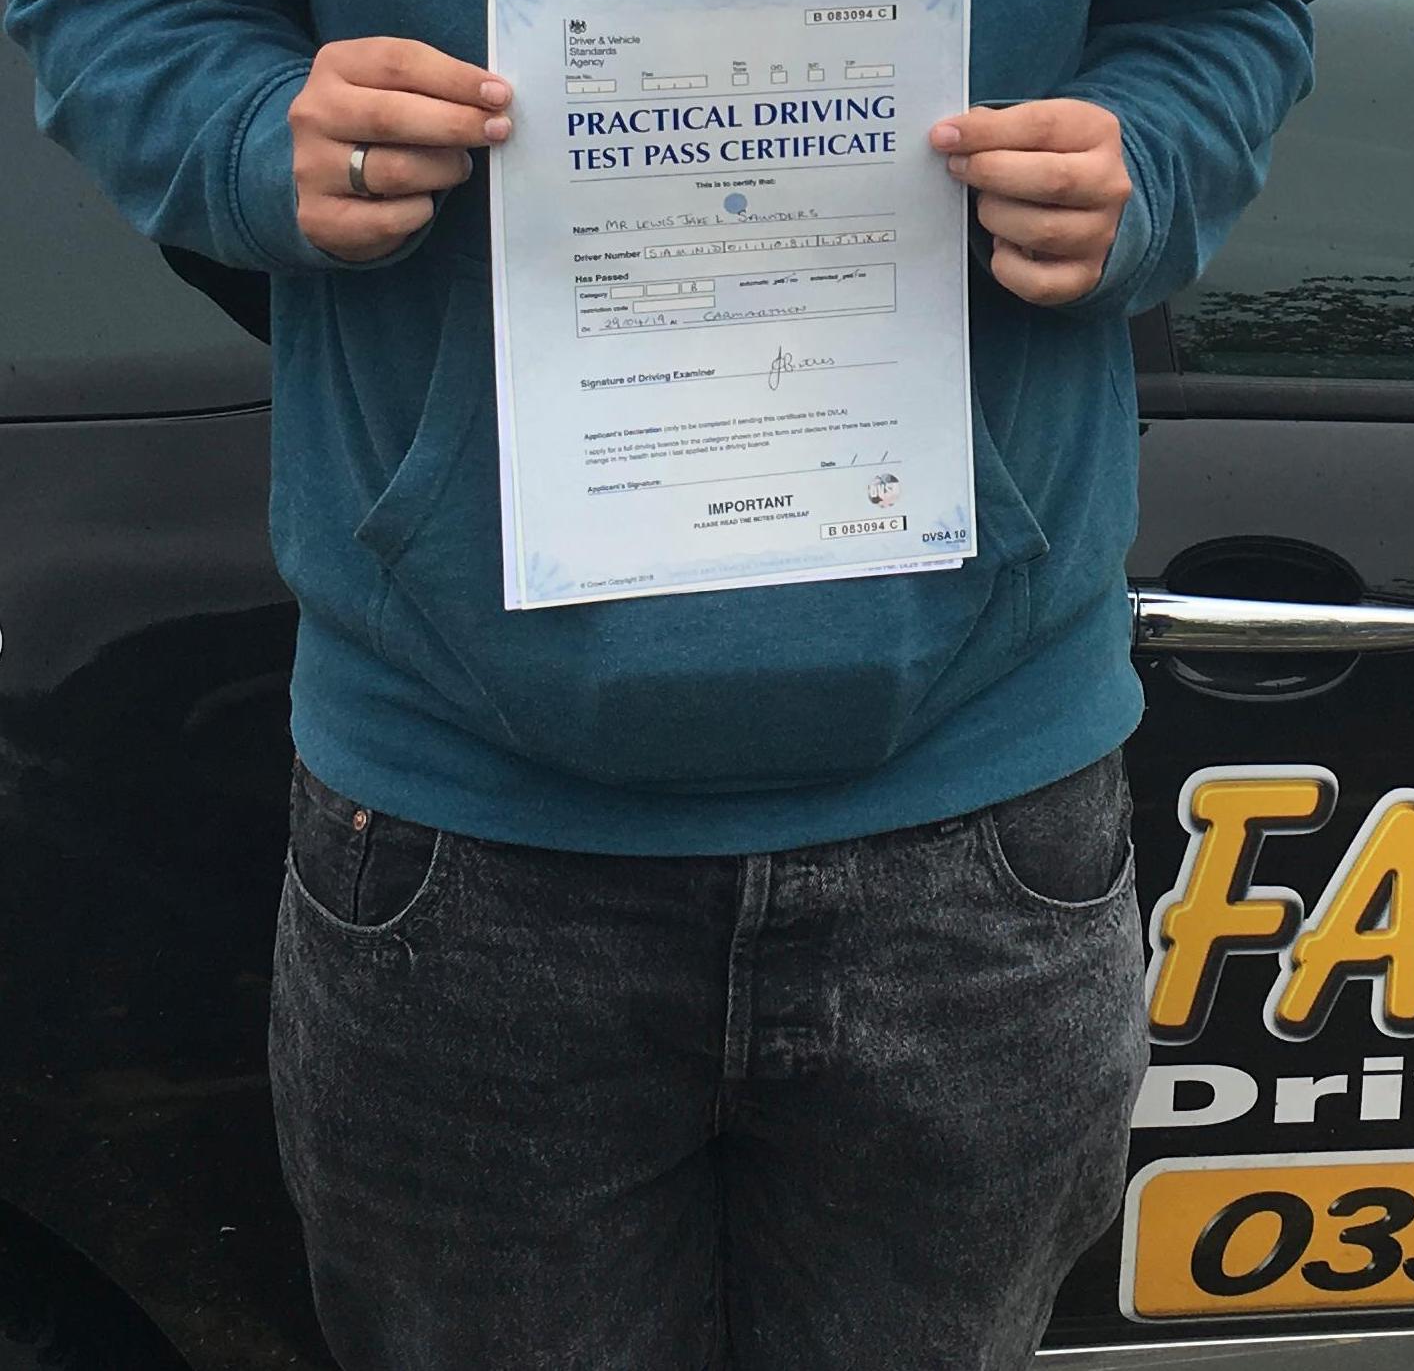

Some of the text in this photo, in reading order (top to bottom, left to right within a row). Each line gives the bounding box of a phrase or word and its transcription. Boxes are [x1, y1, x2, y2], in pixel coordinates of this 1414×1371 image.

[827, 9, 873, 21] 083094
[569, 36, 596, 46] Driver
[608, 35, 641, 45] Vehicle
[569, 47, 617, 56] Standards
[570, 58, 605, 69] Agency
[568, 96, 895, 137] PRACTICAL DRIVING
[569, 131, 896, 170] TEST PASS CERTIFICATE
[573, 226, 599, 234] Name
[574, 251, 641, 262] Driver Number
[596, 273, 629, 282] Passed
[580, 367, 716, 389] Signature of Driving Examiner
[708, 494, 794, 516] IMPORTANT
[922, 531, 951, 543] DVSA
[954, 529, 966, 539] 10
